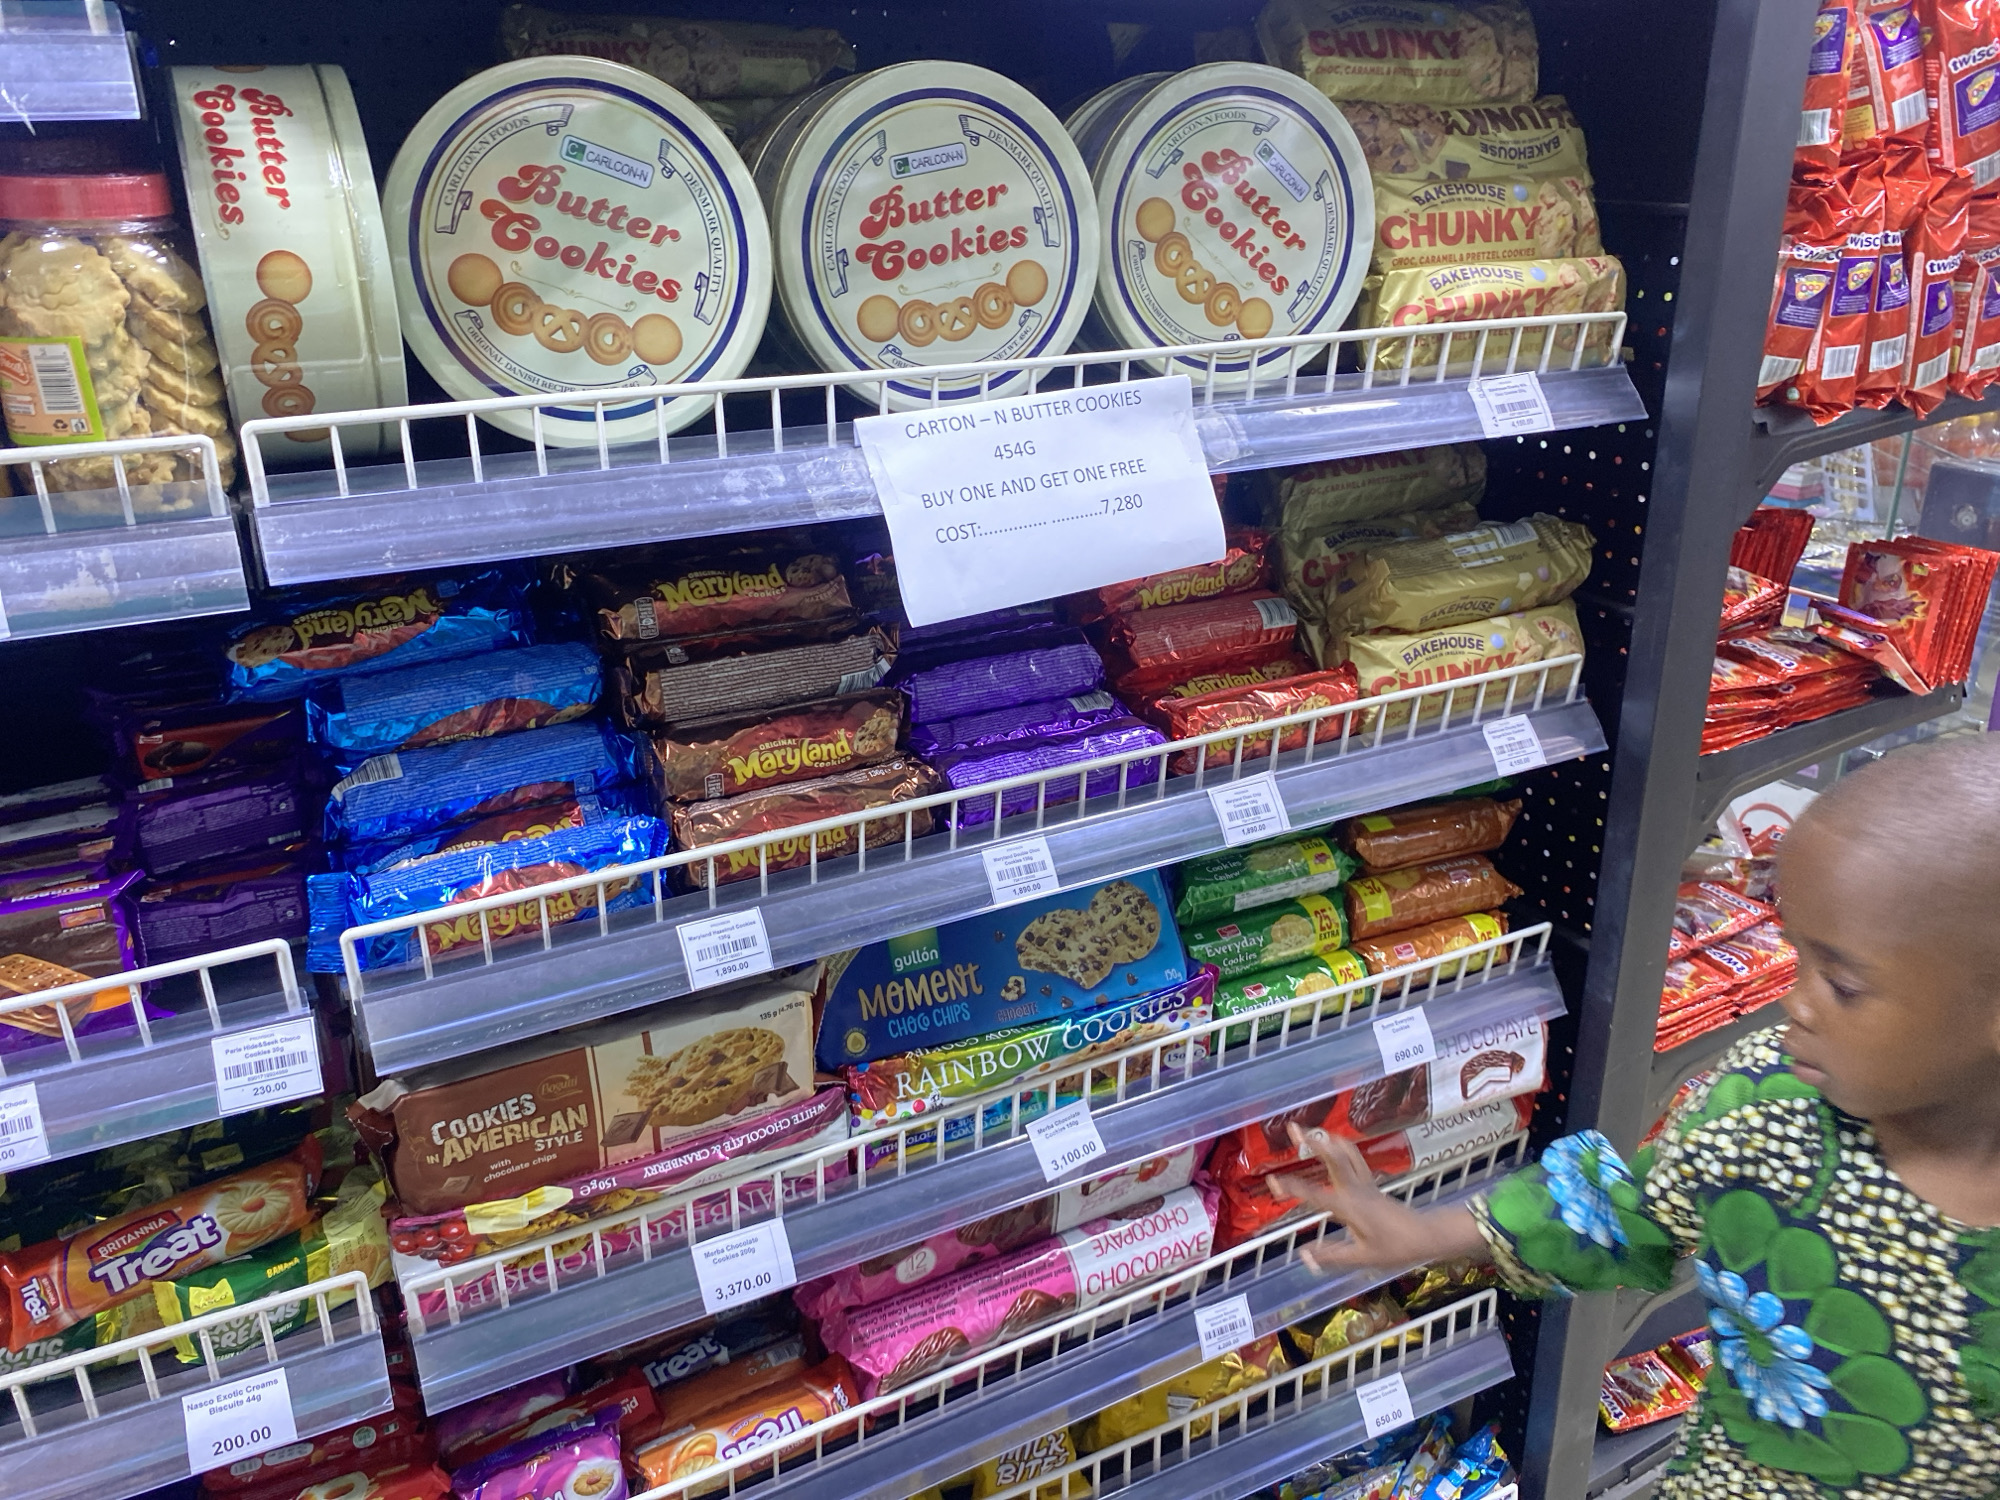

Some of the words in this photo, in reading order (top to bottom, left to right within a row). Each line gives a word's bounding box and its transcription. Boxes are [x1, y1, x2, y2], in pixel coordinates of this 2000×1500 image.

[1307, 28, 1477, 61] CHUNKY
[1161, 114, 1213, 156] CARLCON-N
[1214, 110, 1247, 121] FOODS
[1440, 102, 1583, 137] CHUNKY
[193, 83, 245, 226] Cookies
[239, 87, 294, 210] Butter
[443, 136, 489, 206] CARLCON-N
[490, 115, 531, 144] FOODS
[911, 150, 963, 170] CARLCON-N
[1479, 136, 1560, 158] BAKEHOUSE
[585, 150, 649, 183] CARLCON-N
[987, 129, 1034, 177] DENMARK
[1030, 174, 1055, 221] QUALITY
[497, 164, 681, 247] Butter
[1201, 148, 1306, 251] Butter
[1412, 182, 1506, 207] BAKEHOUSE
[825, 199, 839, 271] CARLCON-N
[838, 160, 860, 196] FOODS
[859, 184, 1008, 239] Butter
[683, 171, 719, 239] DENMARK
[708, 238, 724, 297] QUALITY
[1182, 162, 1289, 295] Cookies
[1326, 202, 1337, 256] DENMARK
[1379, 206, 1541, 250] CHUNKY
[480, 198, 683, 302] Cookies
[855, 225, 1029, 281] Cookies
[1392, 257, 1417, 267] CHOC,
[1418, 254, 1458, 265] CARAMEL
[1466, 250, 1501, 262] PRETZEL
[1502, 247, 1535, 258] COOKIES
[1132, 254, 1147, 291] ORIGINAL
[1306, 258, 1330, 304] QUALITY
[1429, 267, 1524, 292] BAKEHOUSE
[1393, 286, 1560, 325] CHUNKY
[467, 325, 504, 367] ORIGINAL
[504, 365, 541, 388] DANISH
[905, 415, 976, 440] CARTON
[994, 409, 1007, 425] N
[1011, 400, 1072, 423] BUTTER
[1075, 389, 1143, 413] COOKIES
[994, 440, 1036, 461] 454G
[921, 489, 956, 510] BUY
[959, 481, 997, 503] ONE
[1001, 475, 1036, 497] AND
[1040, 469, 1070, 490] GET
[1073, 464, 1108, 485] ONE
[1111, 457, 1147, 477] FREE
[657, 563, 787, 611] Maryland
[687, 569, 727, 579] ORIGINAL
[1138, 566, 1225, 609] Maryland
[293, 587, 440, 650] Maryland
[1419, 601, 1496, 625] BAKEHOUSE
[1402, 635, 1484, 666] BAKEHOUSE
[1371, 653, 1516, 692] CHUNKY
[727, 728, 853, 786] Maryland
[759, 738, 798, 751] ORIGINAL
[1206, 859, 1242, 873] Cookies
[1214, 870, 1240, 881] Cashew
[1013, 883, 1041, 896] 1,890.00
[1315, 907, 1332, 932] 25
[1205, 934, 1265, 958] Everyday
[1319, 930, 1340, 941] EXTRA
[715, 961, 749, 977] 1,890.00
[894, 947, 939, 972] gullón
[1164, 967, 1183, 981] 150g
[1223, 952, 1258, 967] Cookies
[932, 1002, 970, 1027] CHIPS
[243, 1039, 279, 1051] Hide&Seek
[280, 1035, 301, 1044] Choco
[896, 1033, 1052, 1100] RAINBOW
[1062, 989, 1186, 1050] COOKIES
[1395, 1044, 1424, 1062] 690.00
[1434, 1014, 1539, 1061] CHOCOPAYE
[245, 1050, 271, 1059] Cookies
[253, 1081, 287, 1096] 230.00
[431, 1094, 537, 1146] COOKIES
[794, 1102, 826, 1124] WHITE
[1037, 1124, 1054, 1135] Merba
[1054, 1111, 1080, 1126] Chocolate
[426, 1153, 439, 1165] IN
[443, 1104, 590, 1168] AMERICAN
[535, 1131, 583, 1152] STYLE
[724, 1117, 792, 1151] CHOCOLATE
[1045, 1126, 1066, 1139] Cookies
[490, 1158, 511, 1171] with
[644, 1150, 711, 1178] CRANBERRY
[872, 1143, 898, 1157] WITH
[1051, 1141, 1096, 1171] 3,100.00
[484, 1161, 530, 1183] chocolate
[532, 1152, 558, 1168] chips
[98, 1217, 169, 1258] BRITANNIA
[704, 1248, 725, 1259] Merba
[726, 1237, 758, 1251] Chocolate
[1091, 1207, 1189, 1258] CHOCOPAYE
[94, 1216, 220, 1293] Treat
[266, 1257, 300, 1279] BANANA
[712, 1253, 739, 1264] Cookies
[909, 1251, 927, 1272] 12
[1087, 1231, 1207, 1296] CHOCOPAYE
[20, 1276, 50, 1325] Treat
[193, 1292, 229, 1311] NASCO
[715, 1272, 771, 1300] 3,370.00
[643, 1336, 720, 1387] Treat
[187, 1399, 215, 1412] Nasco
[216, 1388, 244, 1405] Exotic
[246, 1378, 279, 1393] Creams
[209, 1400, 244, 1416] Biscuits
[246, 1393, 262, 1406] 44g
[1376, 1409, 1402, 1427] 650.00
[212, 1425, 272, 1456] 200.00
[997, 1451, 1070, 1487] BITES
